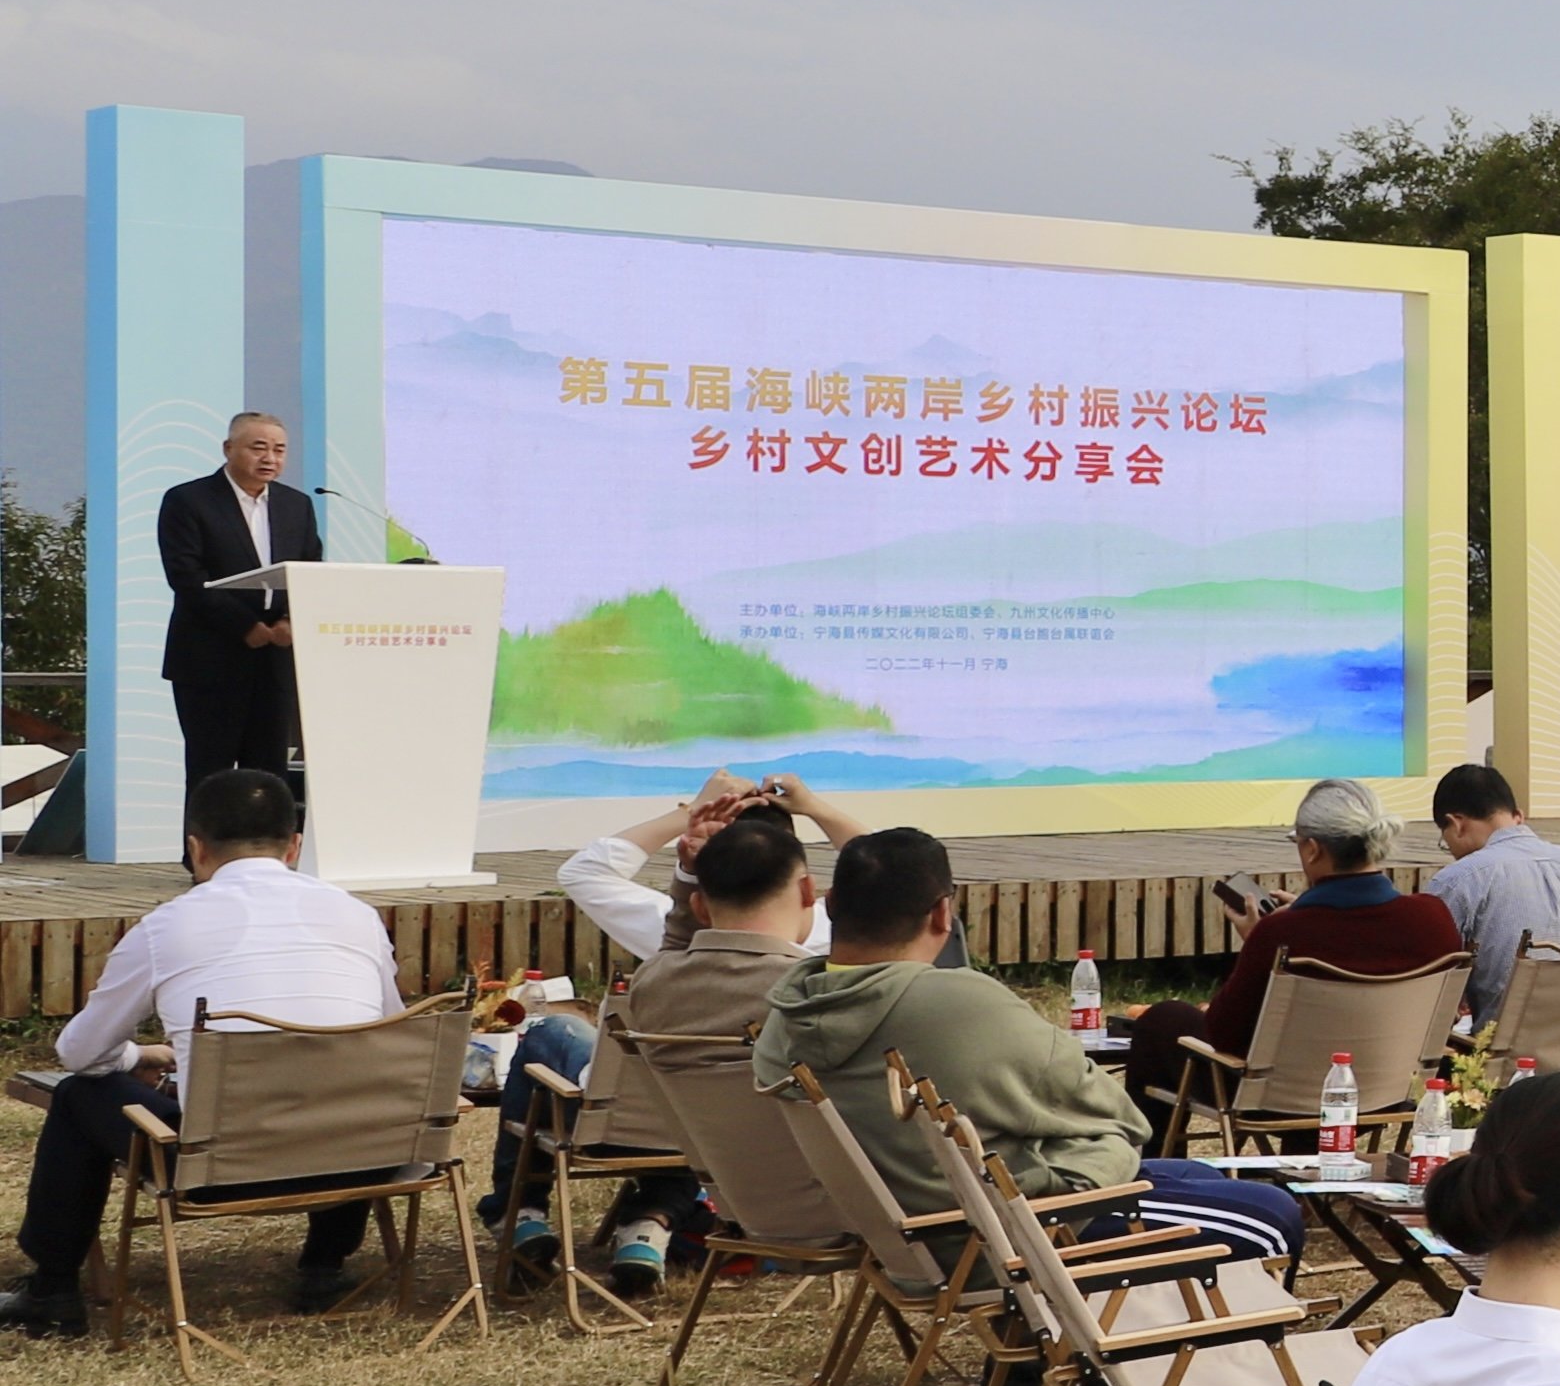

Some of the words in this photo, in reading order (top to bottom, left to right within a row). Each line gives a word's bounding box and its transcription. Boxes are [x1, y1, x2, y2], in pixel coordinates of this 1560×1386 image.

[557, 355, 1269, 436] 第五届海峡两岸乡村振兴论坛
[687, 424, 1165, 486] 乡村文创艺术分享会
